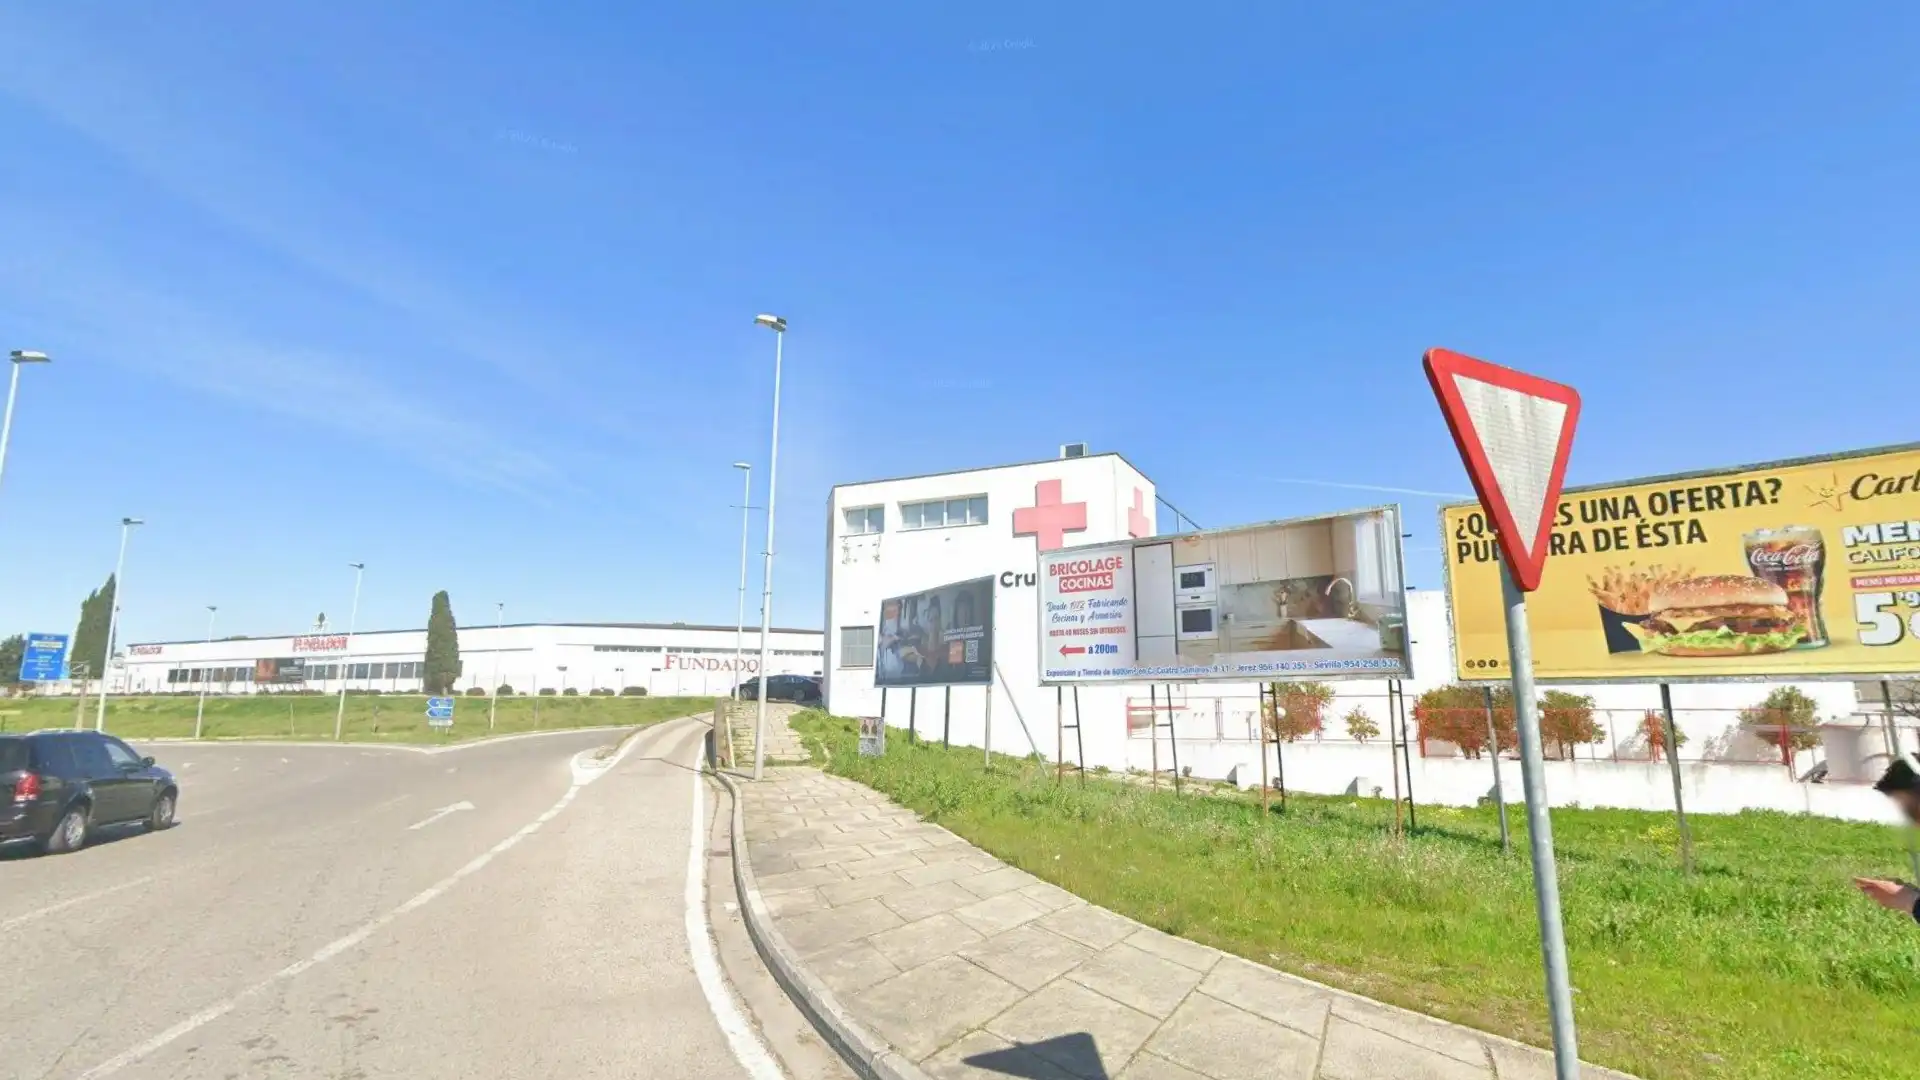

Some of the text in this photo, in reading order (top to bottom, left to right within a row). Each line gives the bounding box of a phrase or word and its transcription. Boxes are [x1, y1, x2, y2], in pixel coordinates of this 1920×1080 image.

[1579, 495, 1642, 524] UNA
[1648, 477, 1783, 517] OFERTA?
[1592, 525, 1630, 552] DE
[1635, 517, 1708, 548] ÉSTA
[1750, 543, 1821, 566] Coca-Cola
[1049, 556, 1124, 577] BRICOLAGE
[1060, 574, 1113, 591] COCINAS
[1087, 596, 1128, 609] Fabricando
[1052, 612, 1078, 624] Cocinas
[1080, 614, 1086, 624] y
[1088, 643, 1118, 655] a 200m
[664, 654, 768, 672] FUNDADO
[1314, 659, 1342, 669] Sevilla
